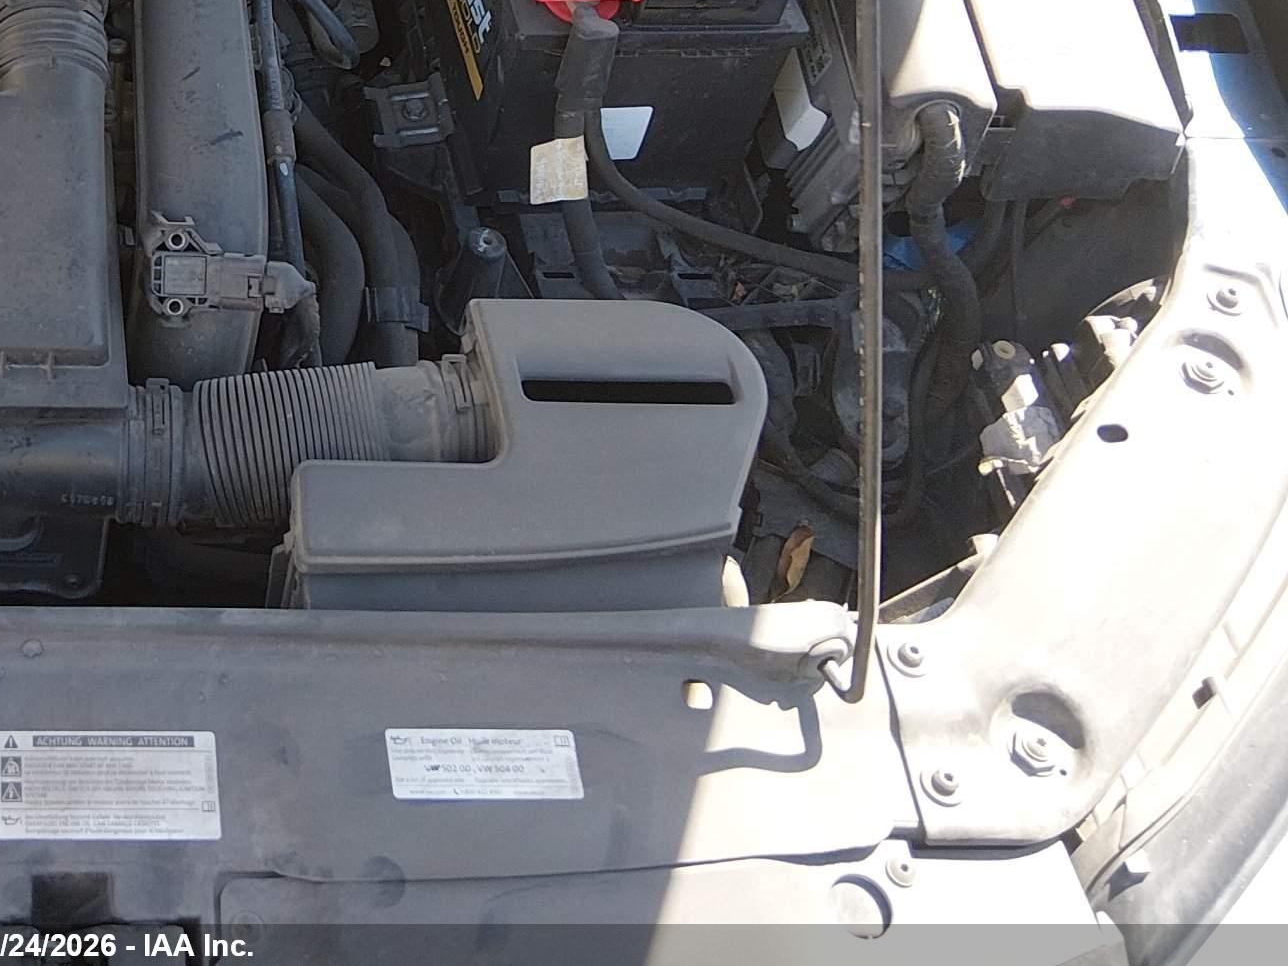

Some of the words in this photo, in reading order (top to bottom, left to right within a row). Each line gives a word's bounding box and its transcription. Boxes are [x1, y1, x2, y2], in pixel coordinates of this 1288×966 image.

[452, 2, 470, 53] TOUGH
[36, 736, 82, 746] ACHTUNG
[87, 736, 133, 746] WARNING
[138, 736, 189, 746] ATTENTION
